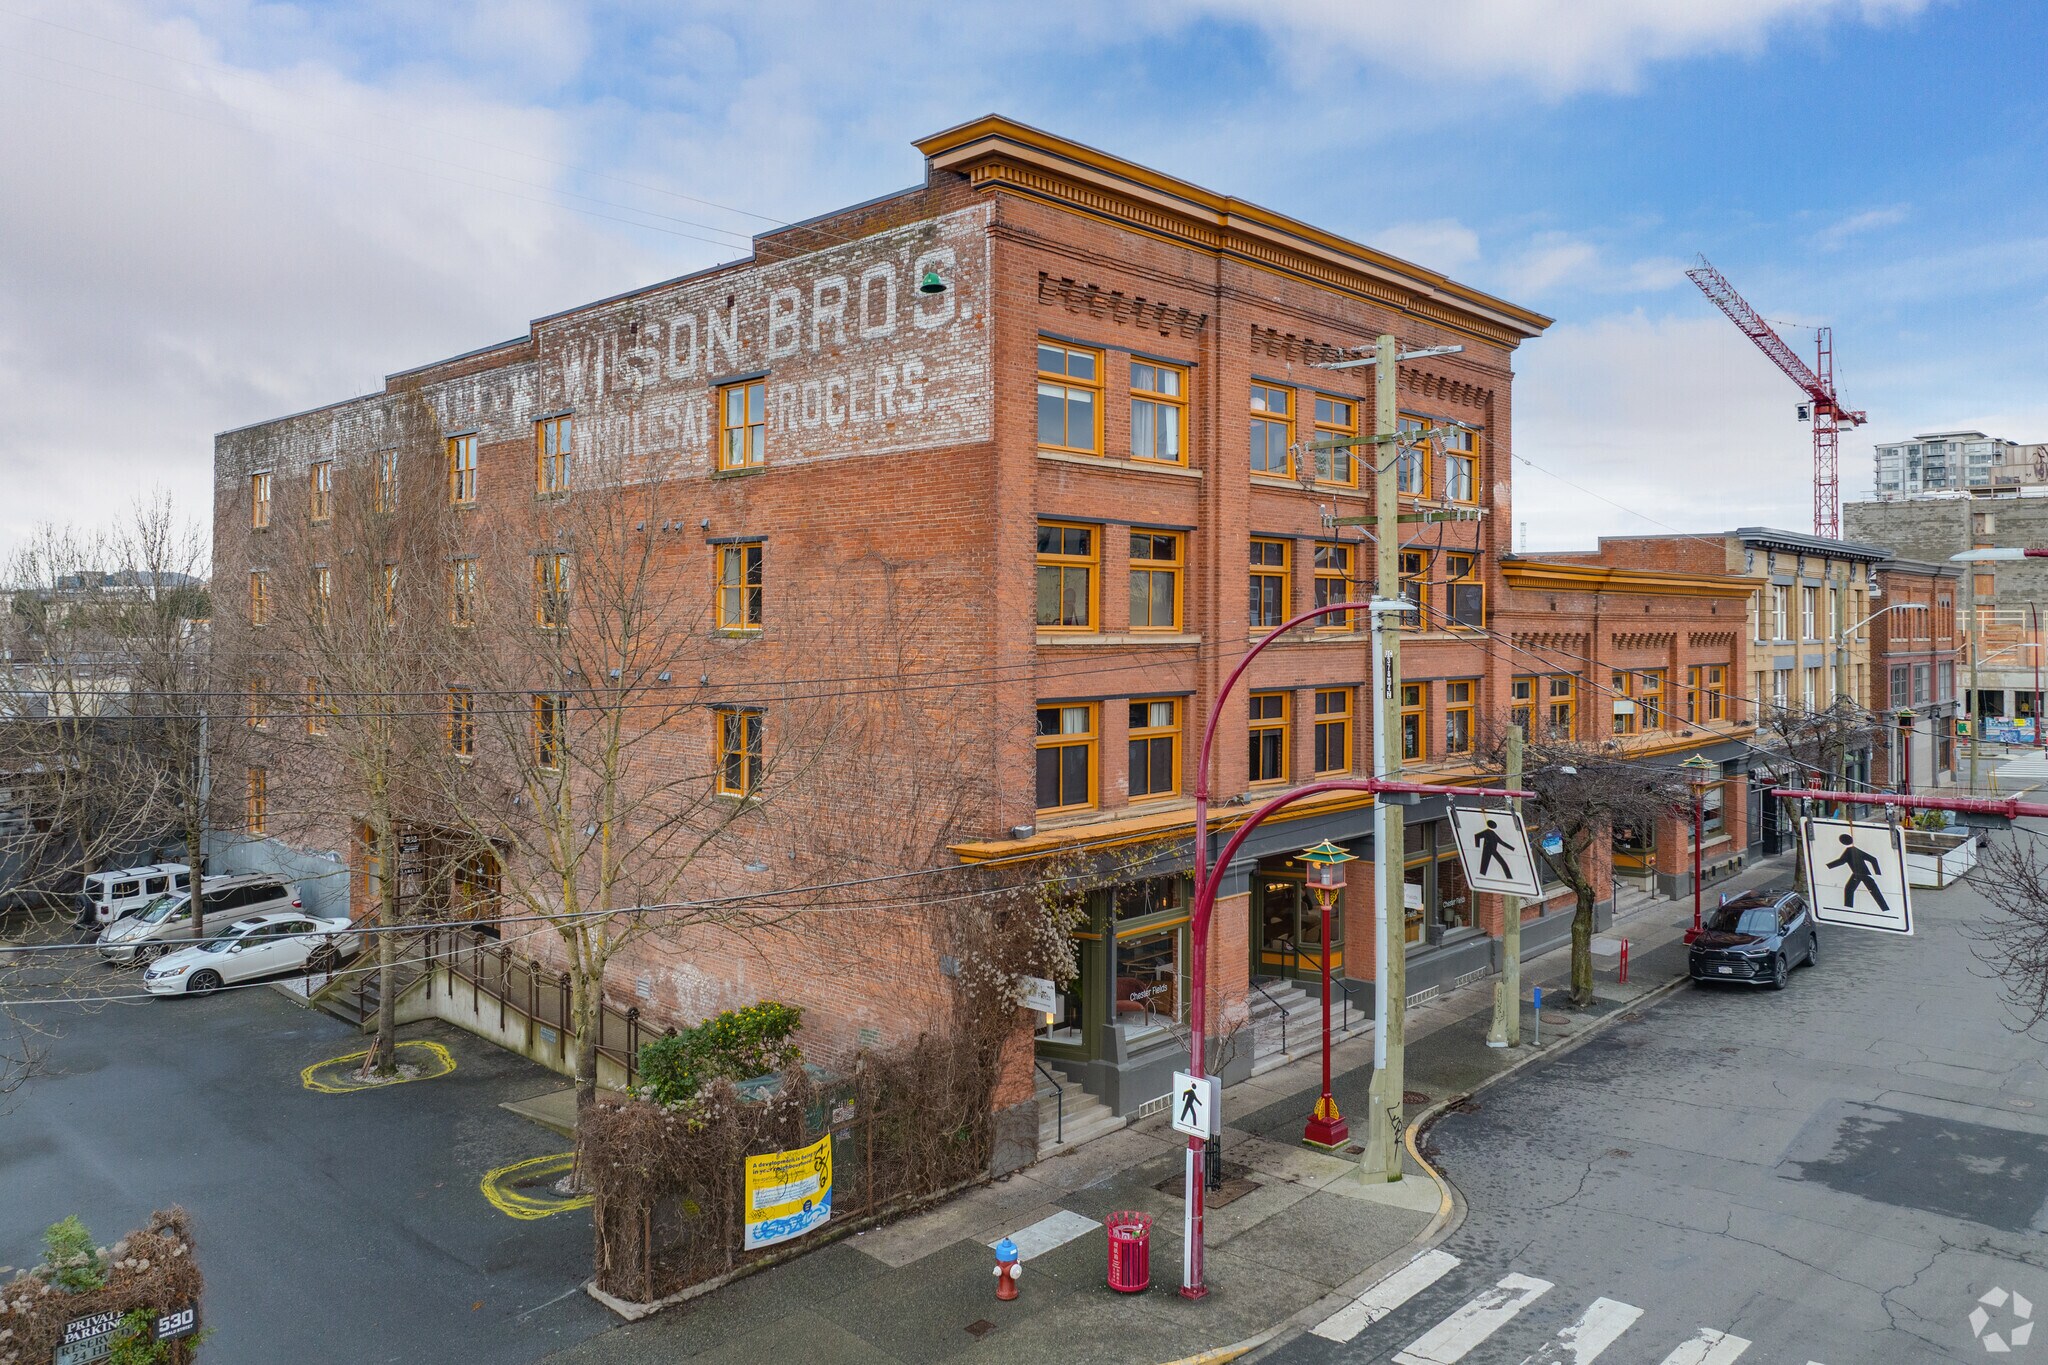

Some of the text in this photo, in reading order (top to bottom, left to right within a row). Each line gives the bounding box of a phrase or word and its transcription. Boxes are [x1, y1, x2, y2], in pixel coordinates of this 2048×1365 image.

[562, 305, 738, 404] WILSON
[577, 361, 925, 463] WHOLESAL ROCERS
[1130, 984, 1168, 1001] Chester Fields
[66, 1310, 125, 1334] PRIVATE
[159, 1309, 194, 1333] 530
[159, 1323, 194, 1338] HERALD STREET
[61, 1328, 131, 1356] RESERVD
[72, 1351, 87, 1363] 24
